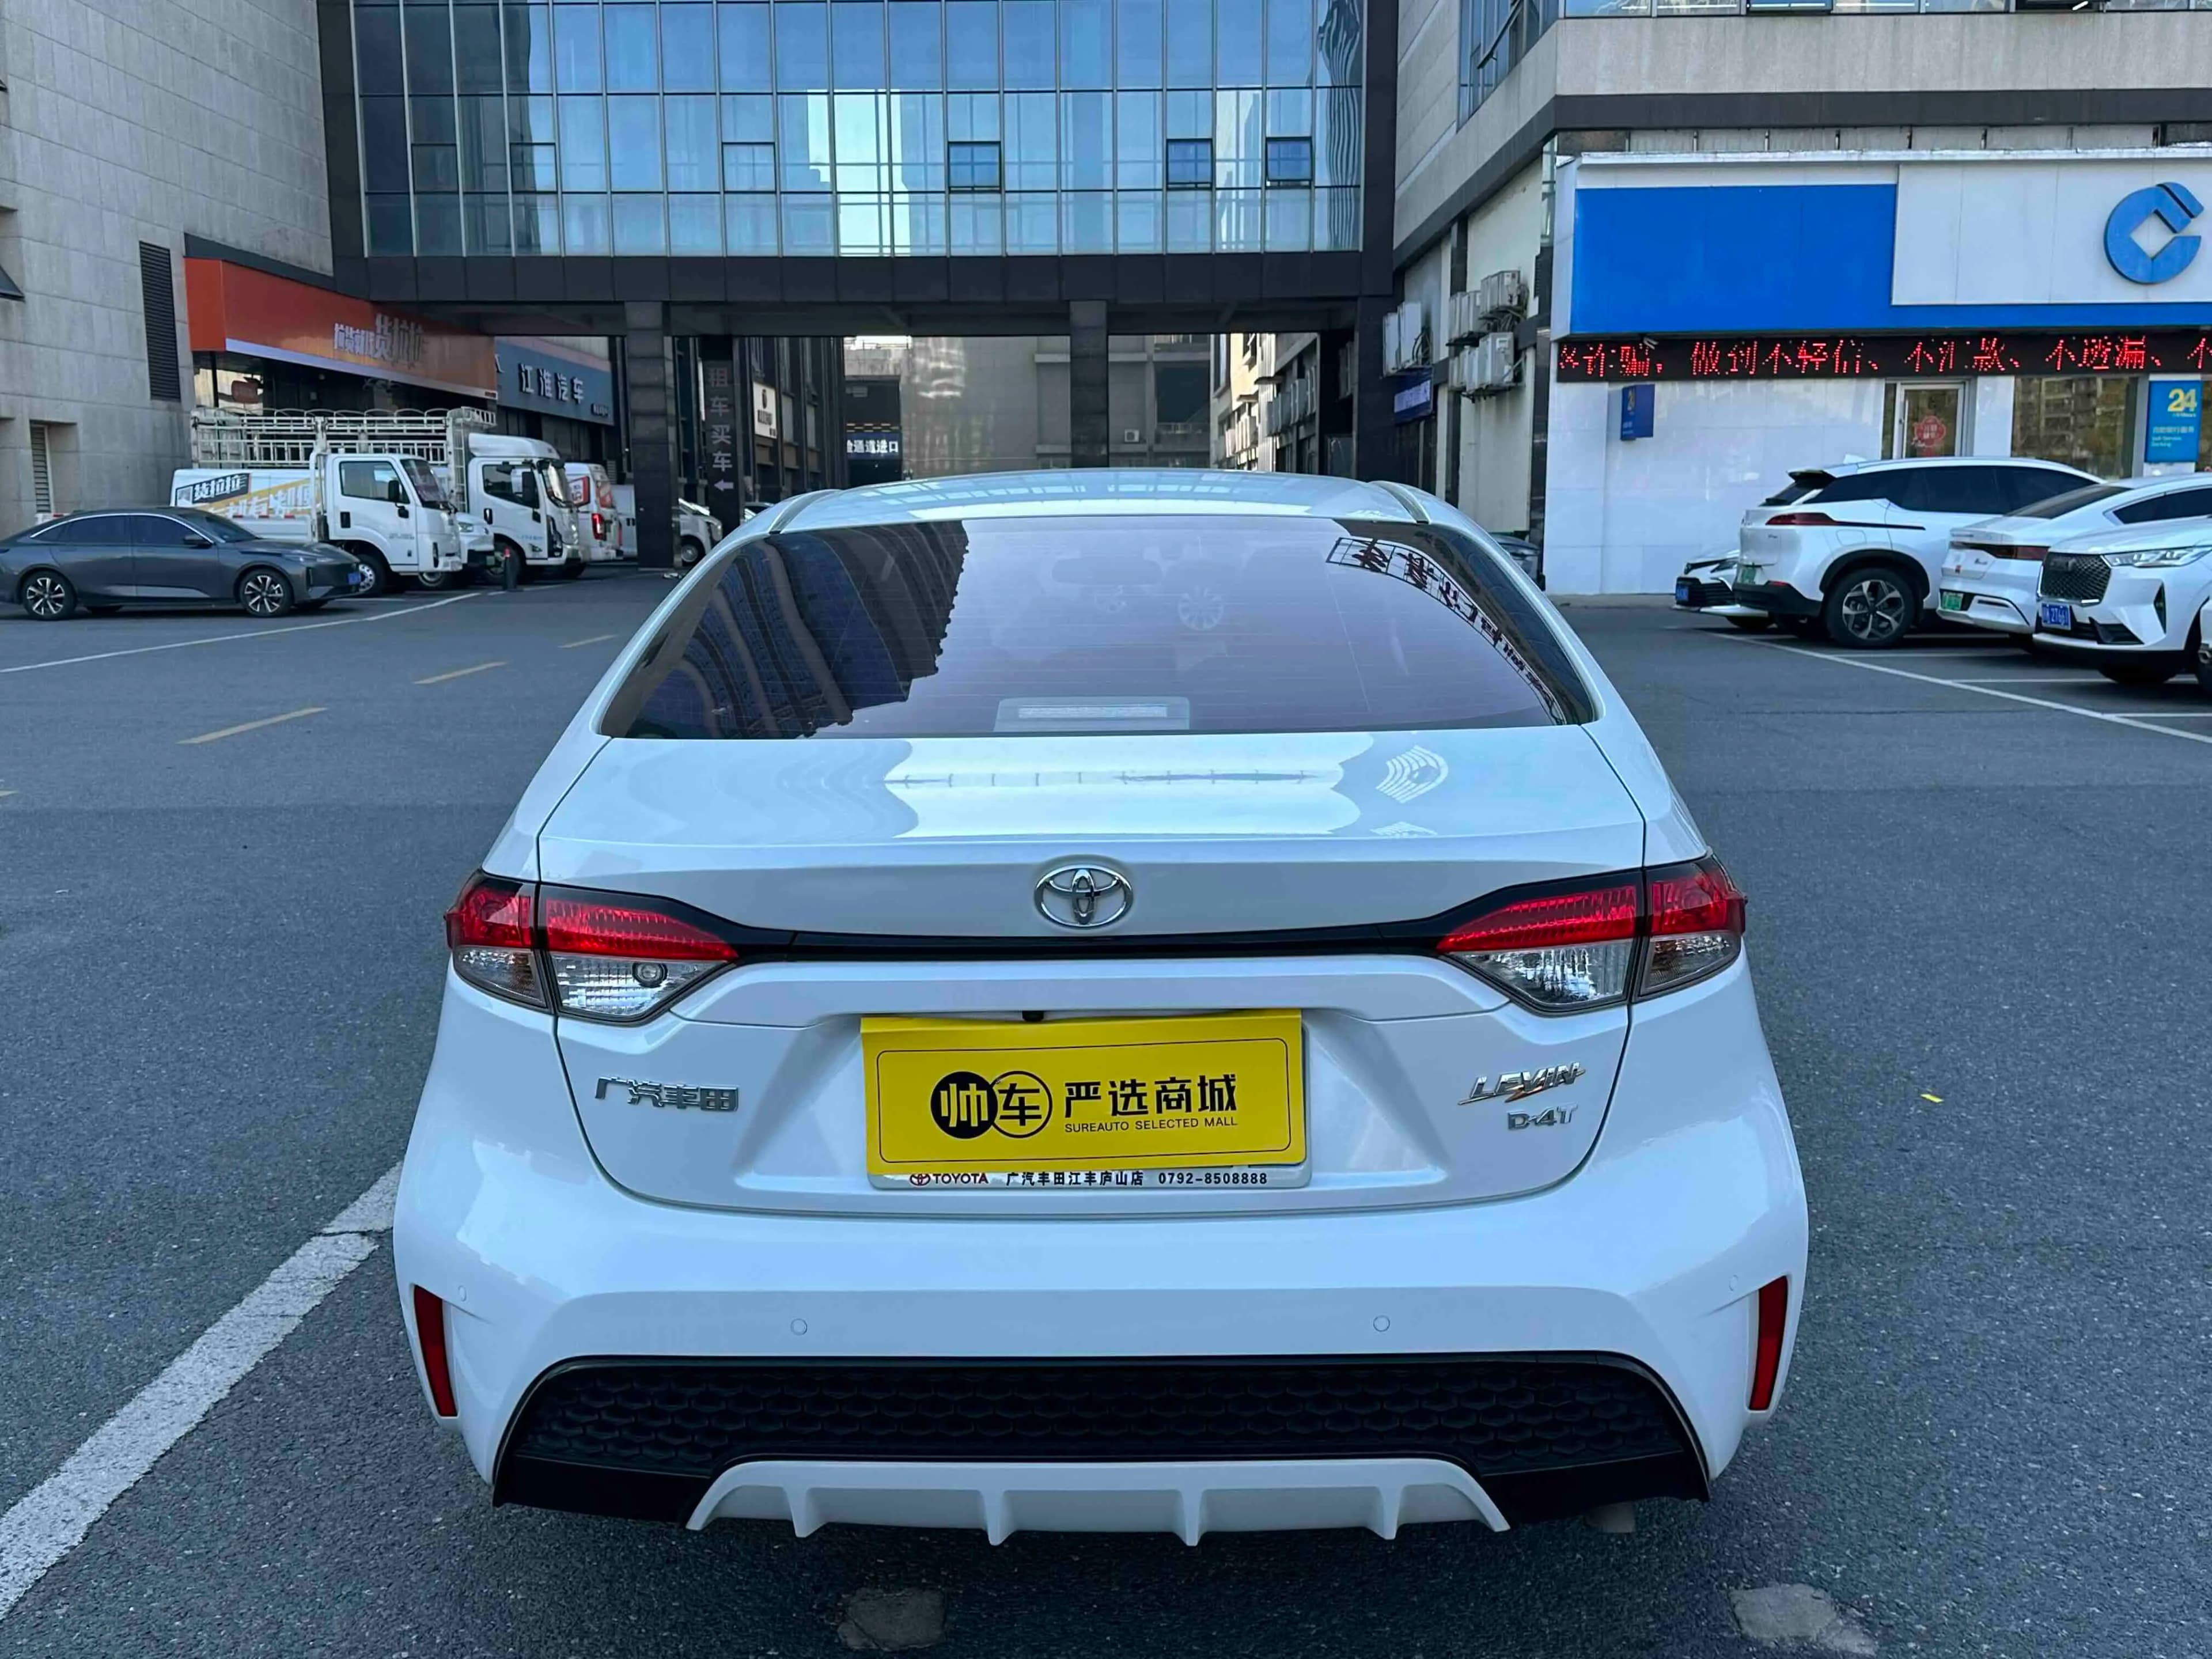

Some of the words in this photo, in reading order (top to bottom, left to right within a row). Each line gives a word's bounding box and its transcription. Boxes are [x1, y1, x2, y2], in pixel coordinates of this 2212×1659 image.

[519, 363, 585, 404] 江淮汽车
[2168, 388, 2197, 412] 24
[707, 367, 733, 472] 租车买车
[194, 475, 241, 500] 货拉拉
[1469, 1062, 1581, 1099] LEVIN
[595, 1076, 739, 1112] 广汽丰田
[939, 1082, 1044, 1127] 帅车
[1065, 1074, 1237, 1118] 严选商城
[1065, 1121, 1130, 1133] SUREAUTO
[1135, 1118, 1199, 1130] SELECTED
[1205, 1116, 1238, 1127] MALL
[934, 1173, 989, 1184] TOYOTA
[1006, 1171, 1143, 1186] 广汽丰田江丰庐山店
[1158, 1172, 1268, 1185] 0792-8508888
